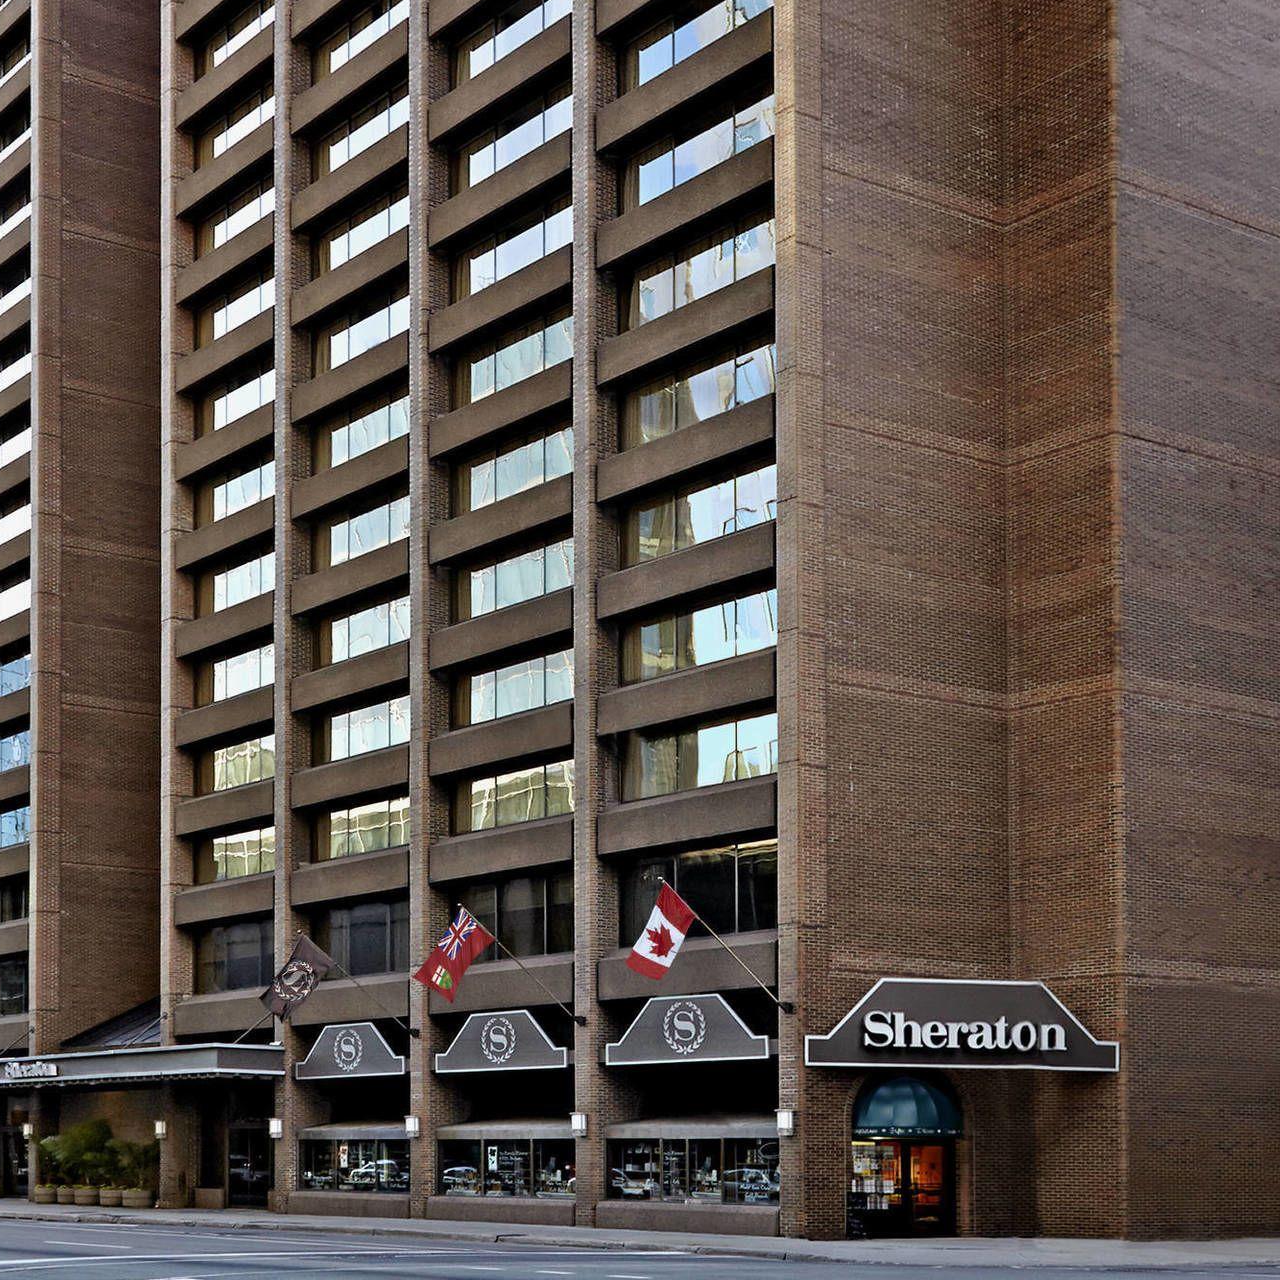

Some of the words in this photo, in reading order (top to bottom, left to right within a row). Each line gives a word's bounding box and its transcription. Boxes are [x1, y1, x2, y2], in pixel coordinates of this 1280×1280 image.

[489, 1025, 508, 1052] S
[673, 1010, 696, 1041] S
[863, 1010, 1068, 1052] Sheraton
[340, 1036, 357, 1061] S
